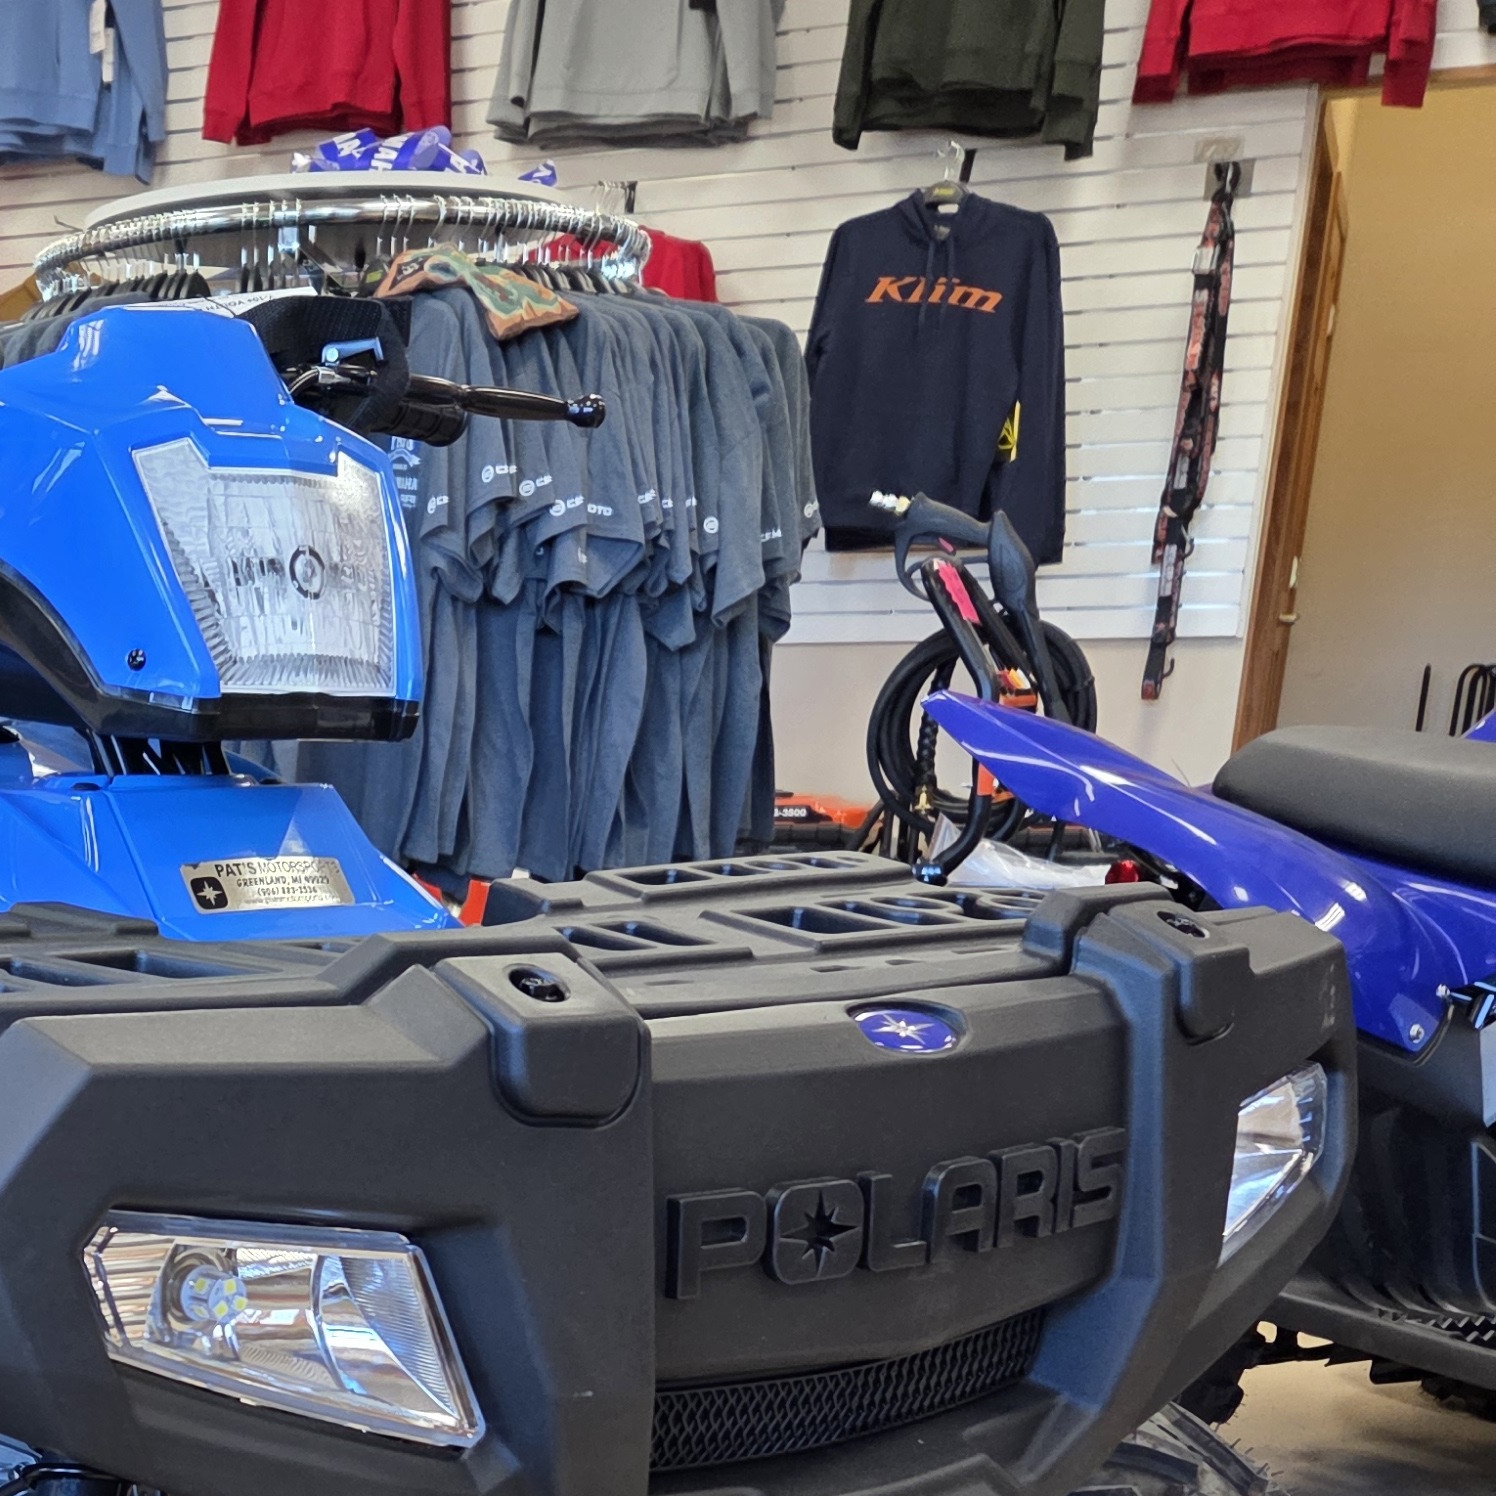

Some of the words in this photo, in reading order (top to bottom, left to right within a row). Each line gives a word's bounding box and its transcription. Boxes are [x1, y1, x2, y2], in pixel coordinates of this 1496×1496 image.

[864, 276, 1003, 313] Klim
[214, 862, 257, 878] PAT'S
[236, 875, 290, 888] GREENLAND,
[291, 875, 302, 884] MI
[664, 1126, 1126, 1300] POLARIS
